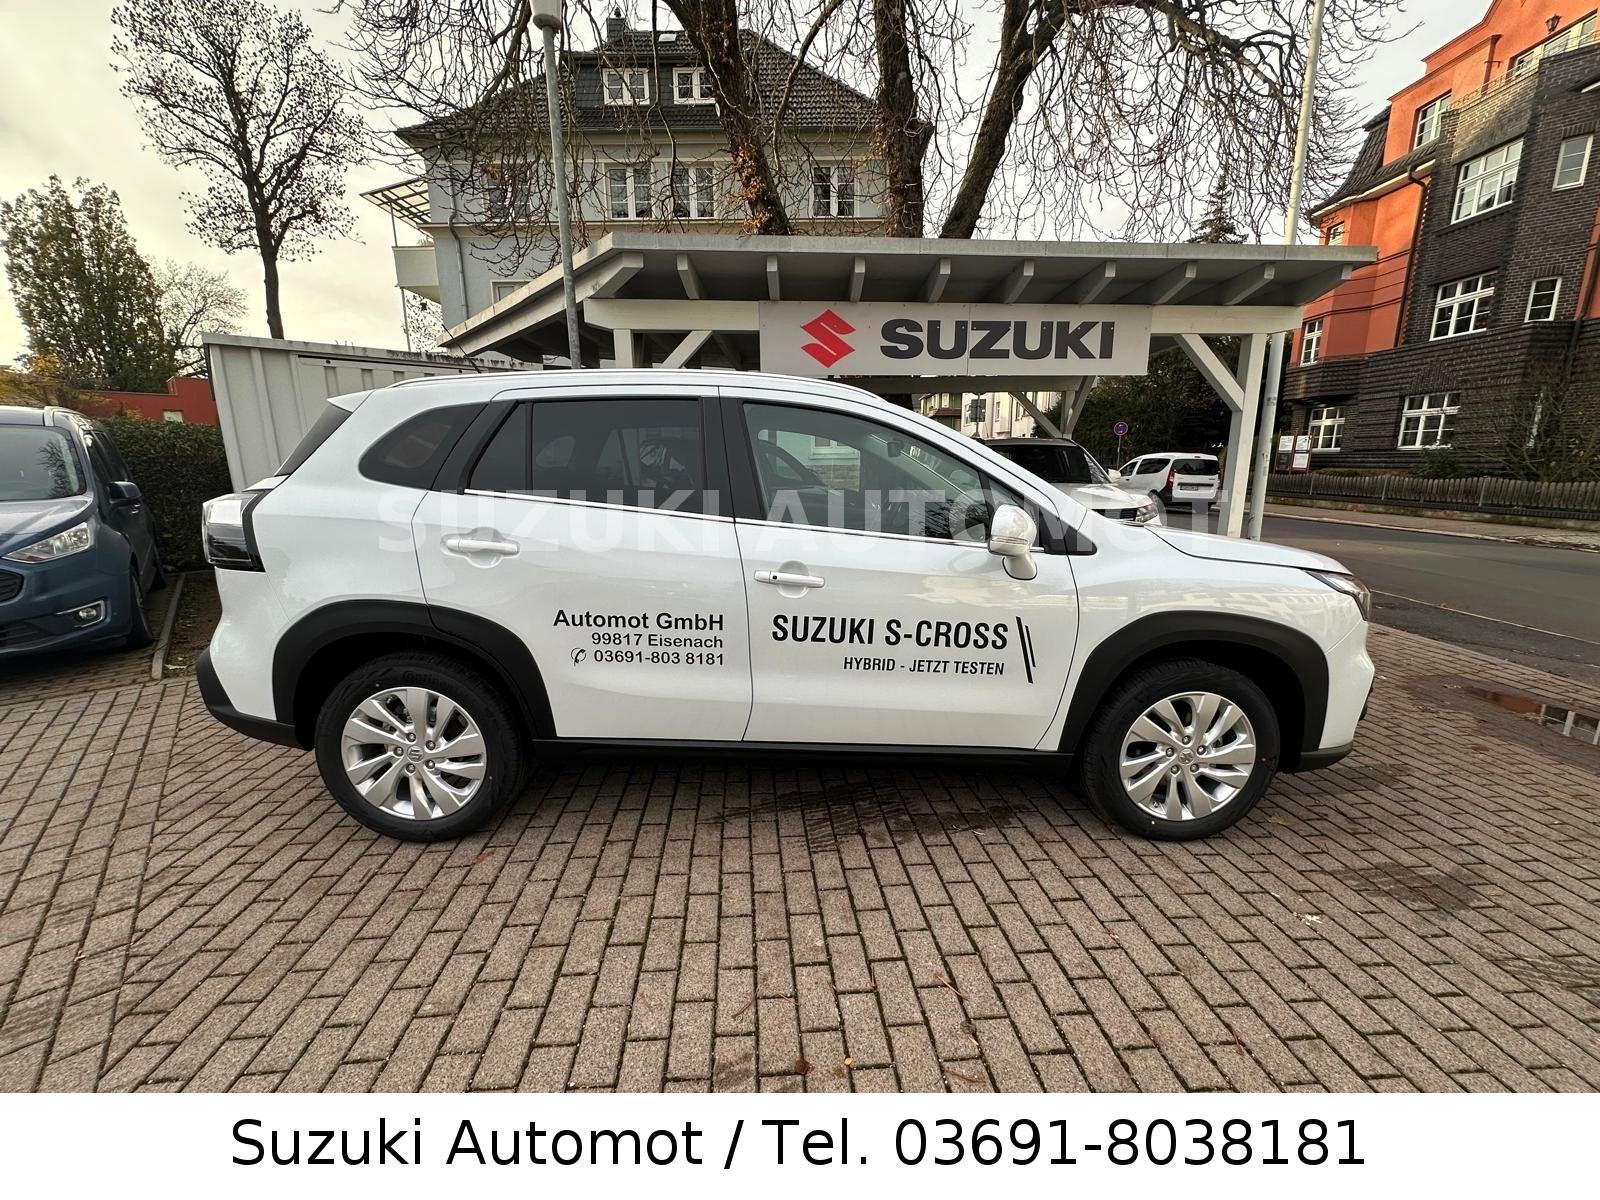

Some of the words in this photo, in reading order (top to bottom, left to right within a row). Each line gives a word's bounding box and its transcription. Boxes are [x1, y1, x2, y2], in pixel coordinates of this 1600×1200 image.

[879, 317, 1116, 360] SUZUKI
[553, 609, 650, 629] Automot
[656, 612, 724, 631] GmbH
[591, 632, 643, 647] 99817
[647, 633, 724, 649] Eisenach
[771, 614, 875, 645] SUZUKI
[884, 618, 1009, 650] S-CROSS
[593, 649, 682, 665] 03691-803
[685, 652, 724, 666] 8181
[843, 656, 896, 672] HYBRID
[908, 659, 950, 674] JETZT
[953, 660, 1005, 676] TESTEN
